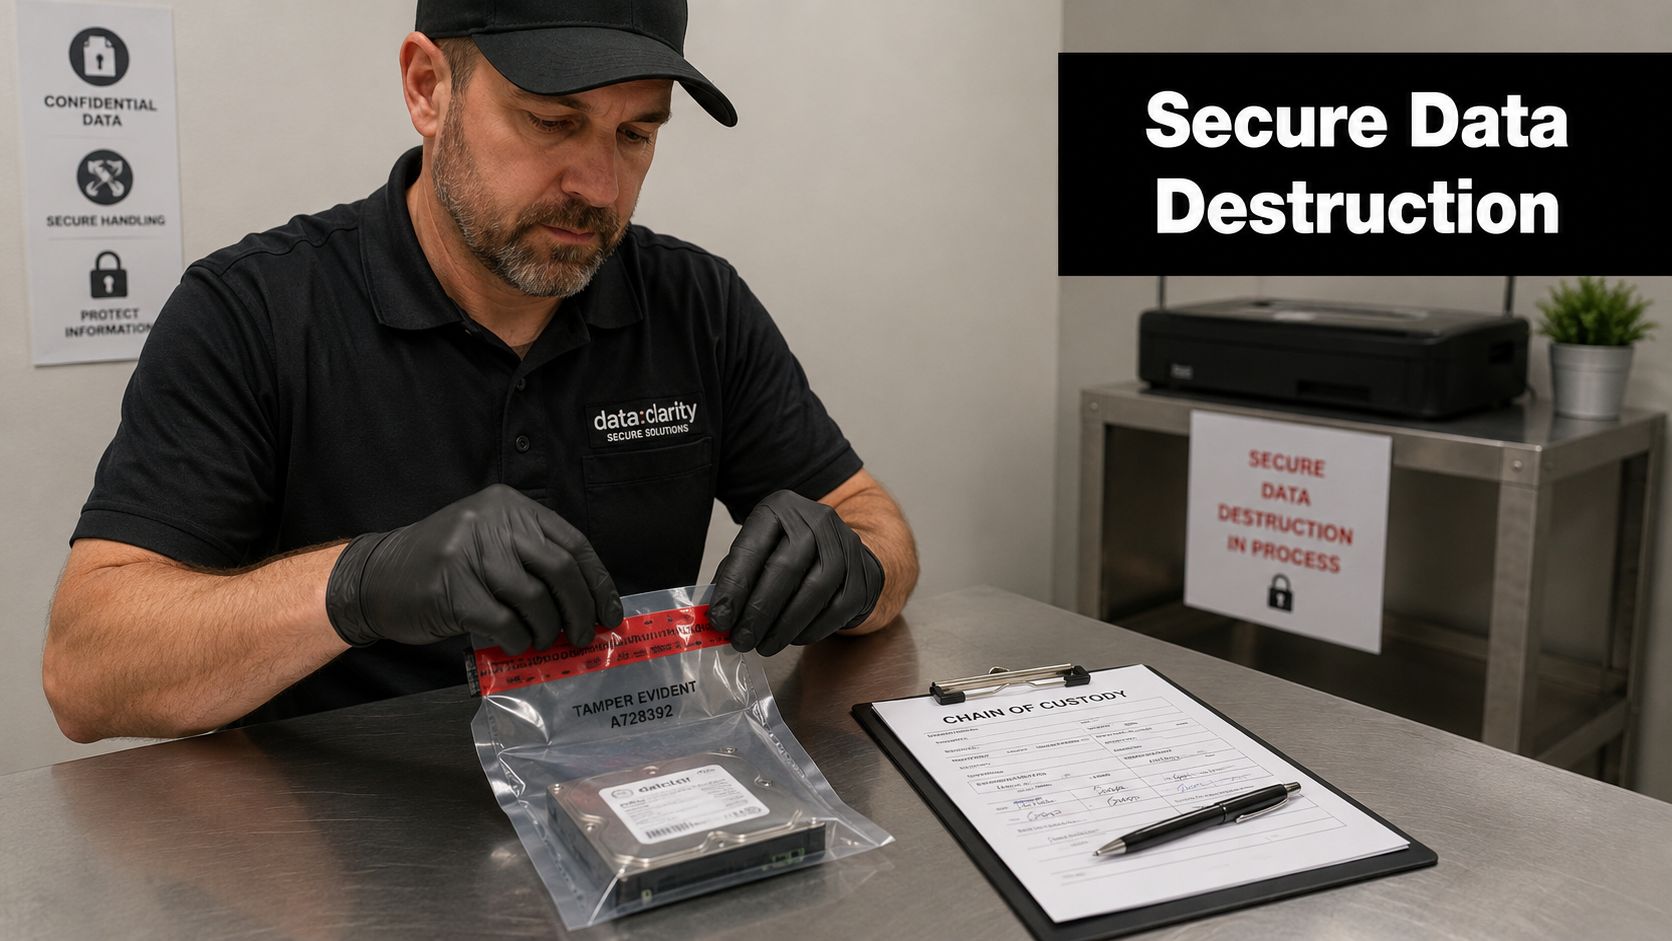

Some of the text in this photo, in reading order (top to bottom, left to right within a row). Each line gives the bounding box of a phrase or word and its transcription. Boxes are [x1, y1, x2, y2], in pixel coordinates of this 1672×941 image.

[44, 95, 157, 111] CONFIDENTIAL
[82, 113, 122, 127] DATA
[46, 214, 166, 227] SECURE HANDLING
[80, 308, 139, 321] PROTECT
[606, 423, 689, 442] SECURE SOLUTIONS
[1248, 449, 1326, 478] SECURE
[1261, 481, 1312, 507] DATA
[1217, 503, 1354, 545] DESTRUCTION
[1227, 534, 1342, 574] IN PROCESS
[572, 680, 697, 718] TAMPER EVIDENT
[942, 690, 1128, 725] CHAIN OF CUSTODY
[610, 704, 674, 729] A728392
